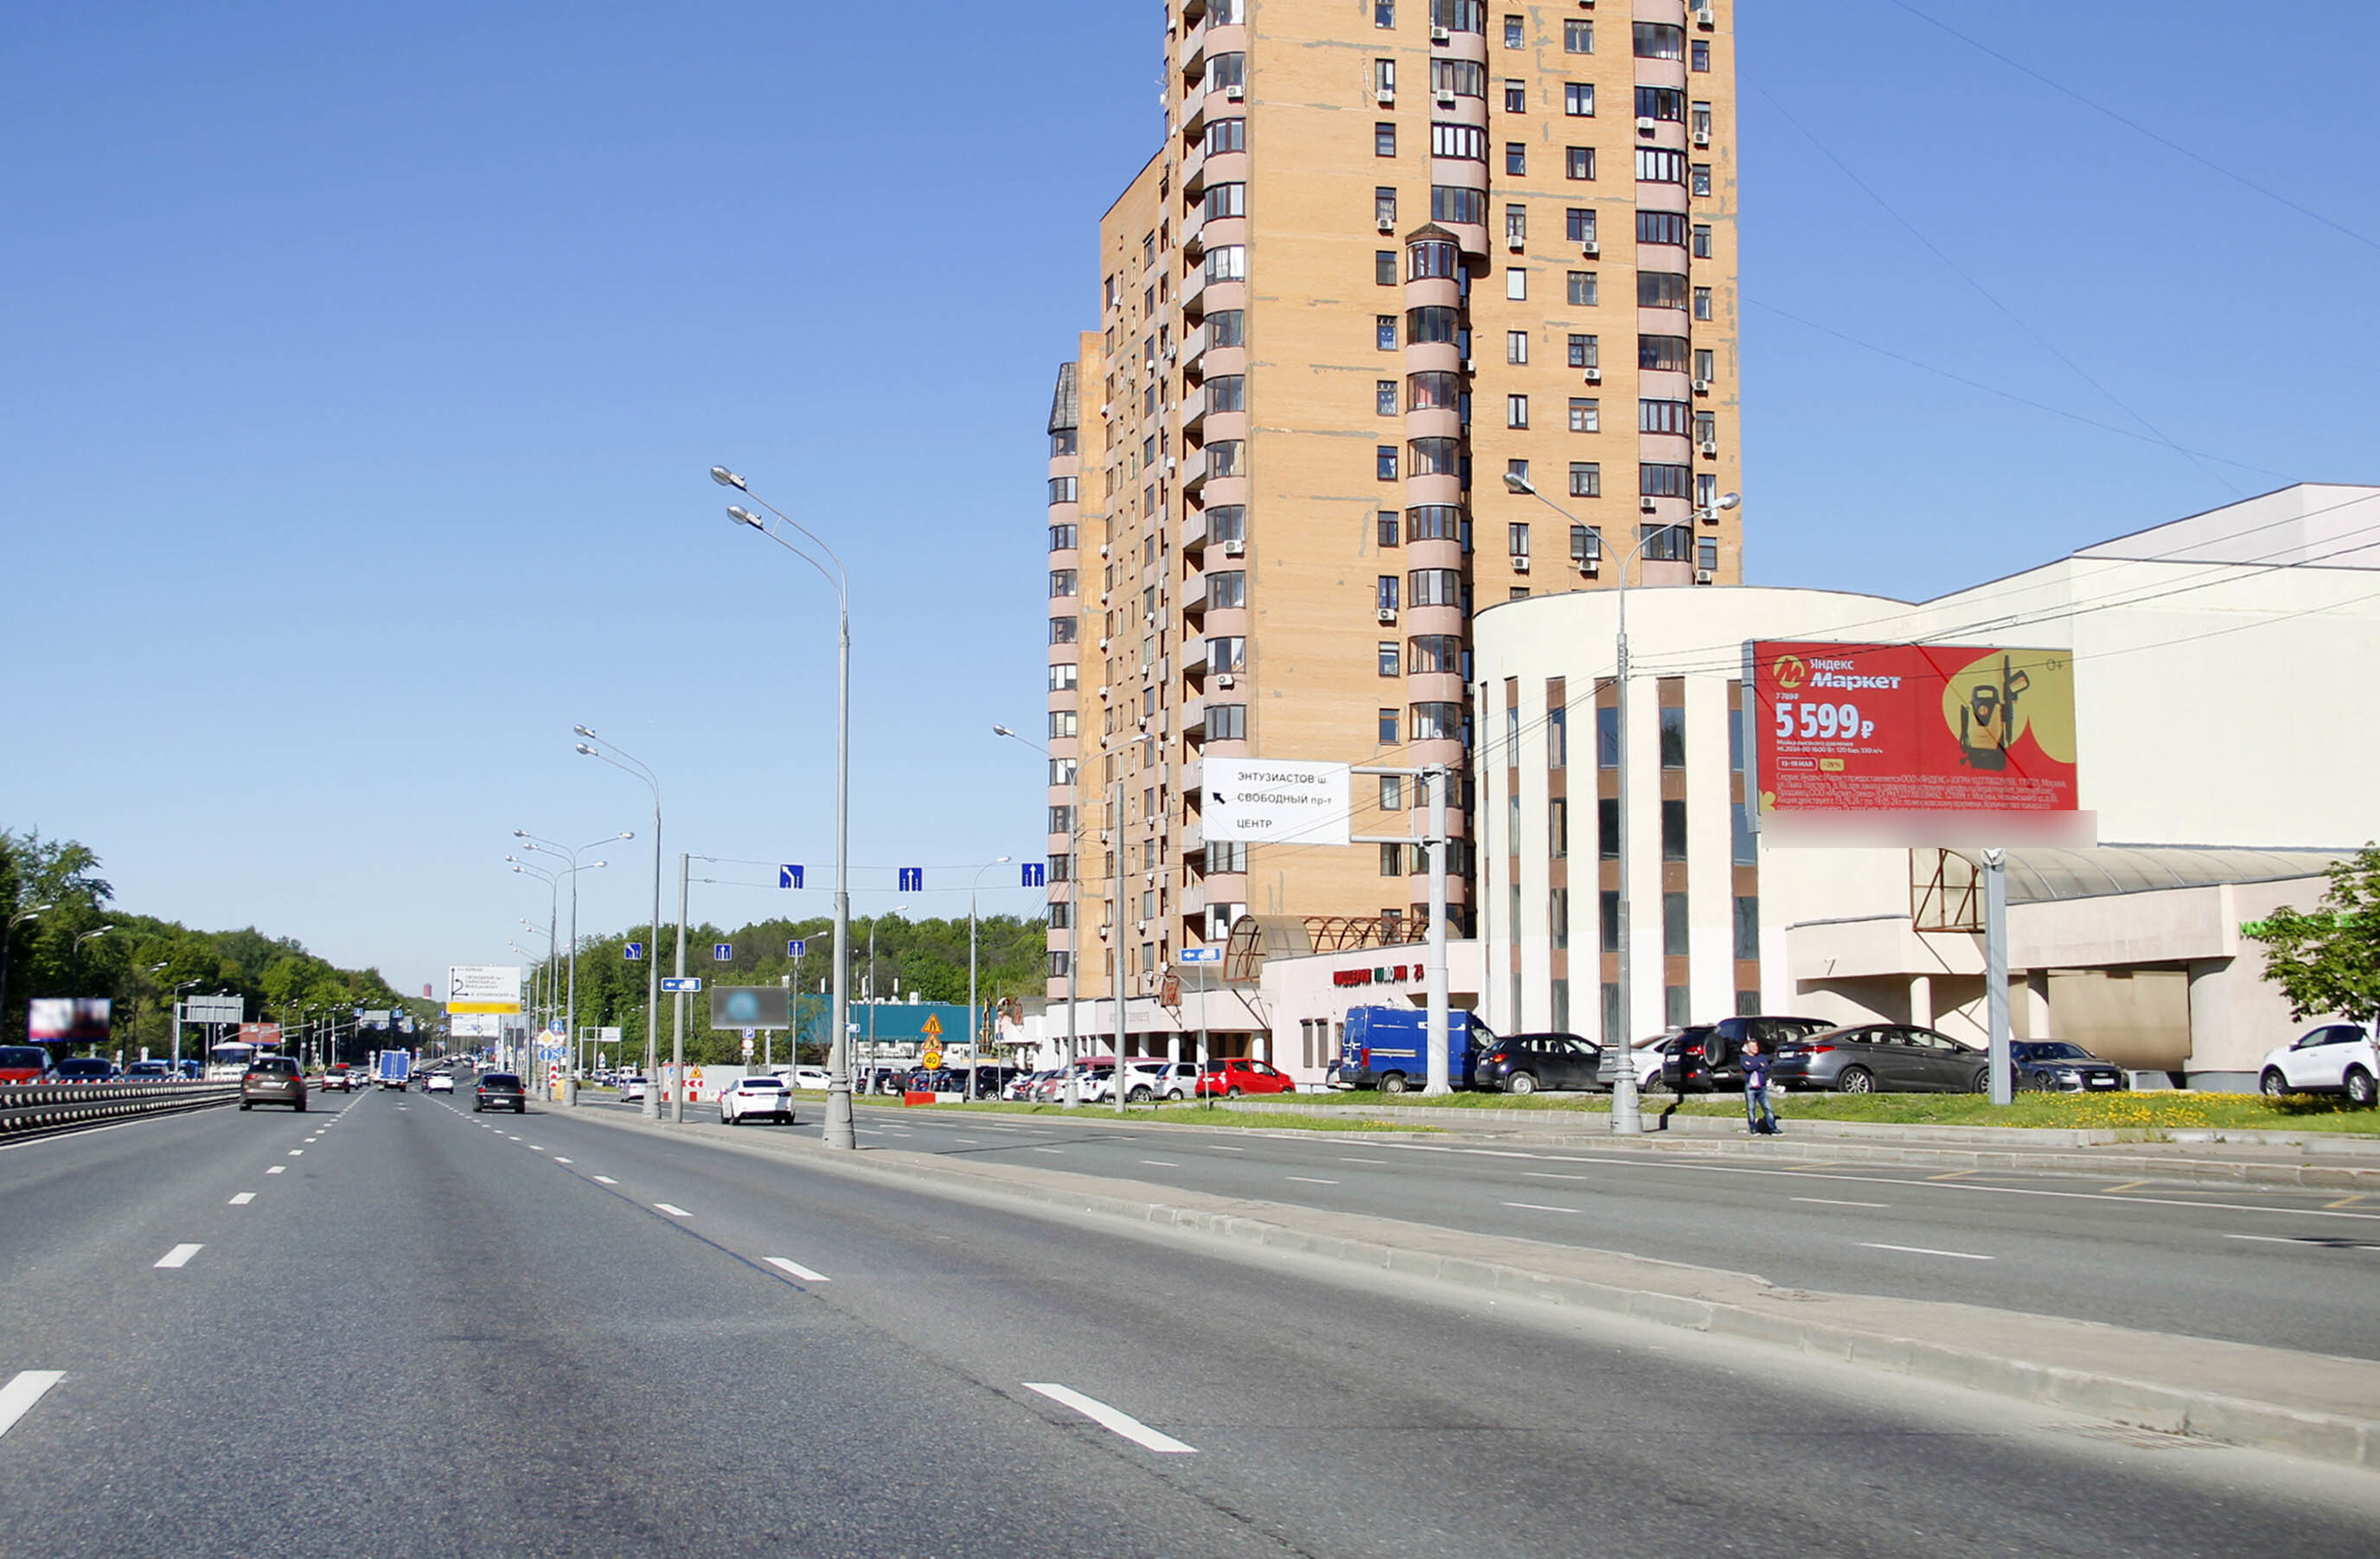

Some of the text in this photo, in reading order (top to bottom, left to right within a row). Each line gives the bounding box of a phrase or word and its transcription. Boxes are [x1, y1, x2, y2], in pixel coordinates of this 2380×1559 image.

[1809, 659, 1854, 671] Яндекс
[1809, 672, 1902, 691] Маркет
[1238, 771, 1315, 783] ЭНТУЗИАСТОВ
[1237, 792, 1332, 807] СВОБОДНЫЙ пр-т
[1237, 819, 1272, 829] ЦЕНТР
